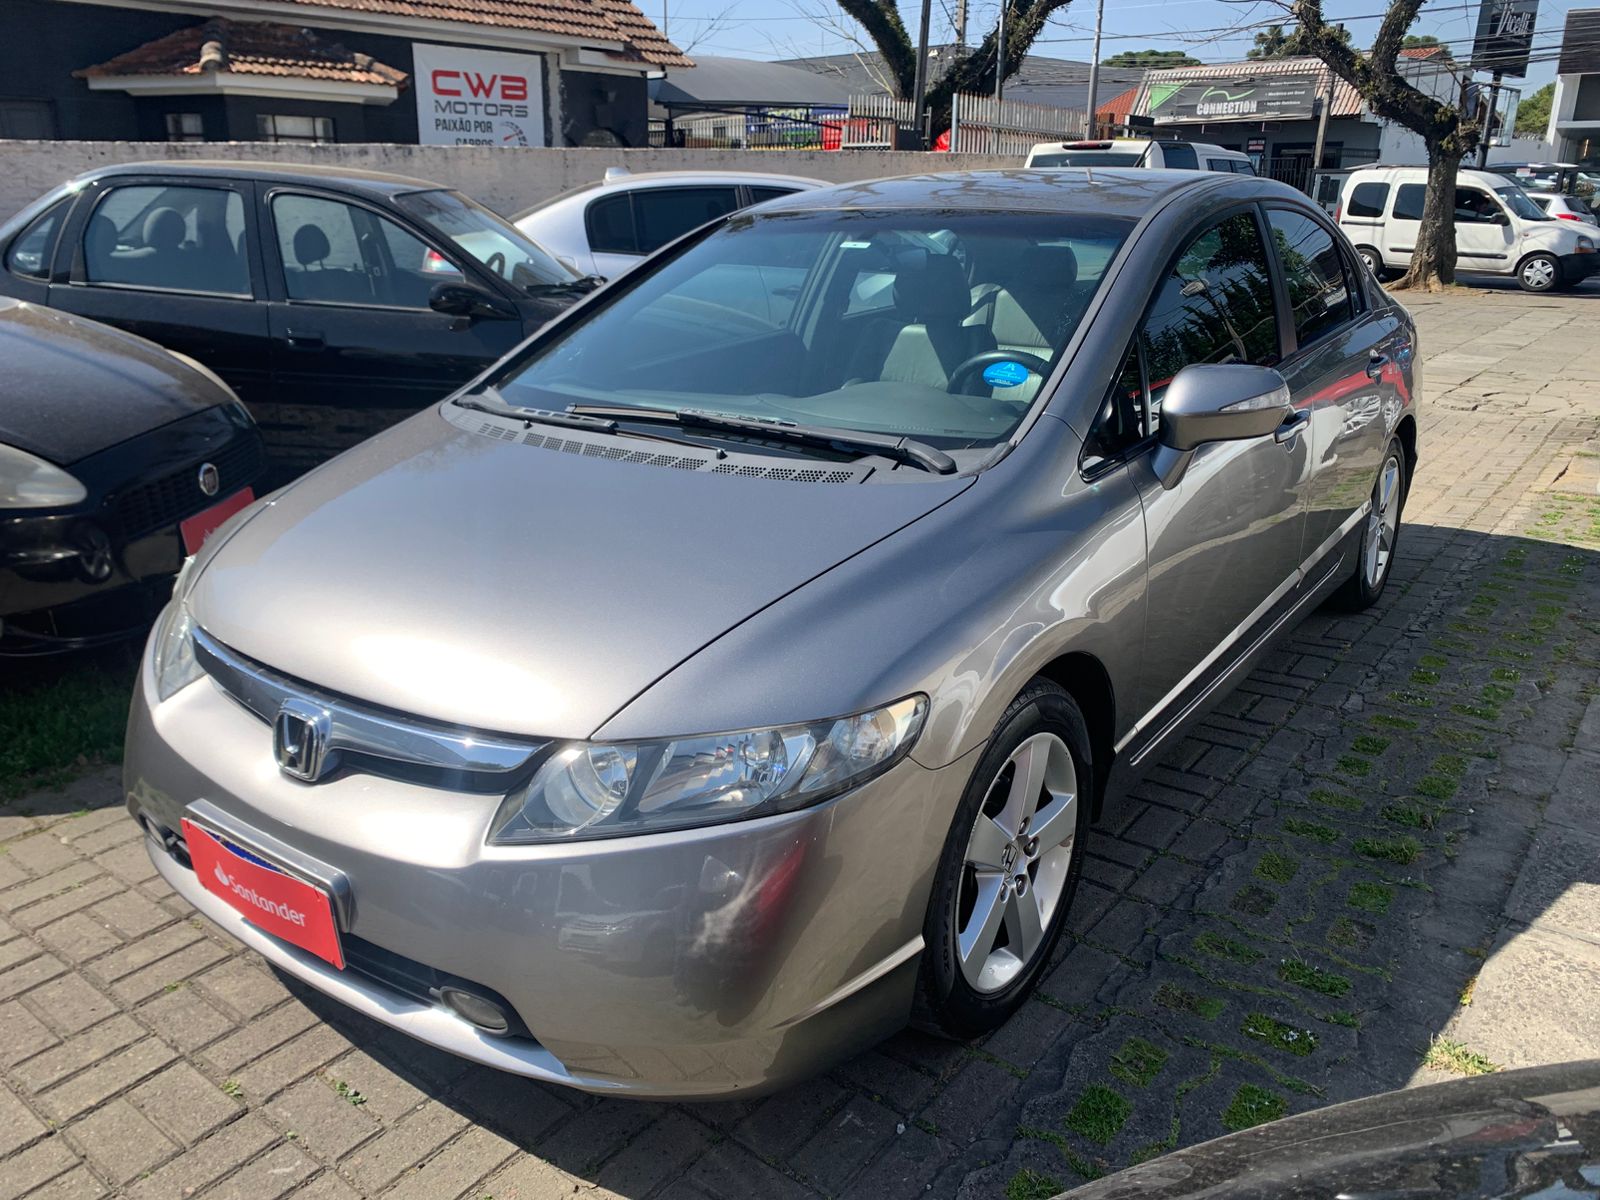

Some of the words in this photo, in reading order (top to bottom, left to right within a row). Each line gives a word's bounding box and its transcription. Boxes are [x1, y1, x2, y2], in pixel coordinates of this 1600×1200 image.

[431, 69, 528, 101] CWB
[434, 100, 529, 118] MOTORS
[1196, 100, 1257, 115] CONNECTION
[435, 117, 471, 132] PAIXÃO
[473, 120, 493, 133] POR
[228, 874, 306, 927] Santander
